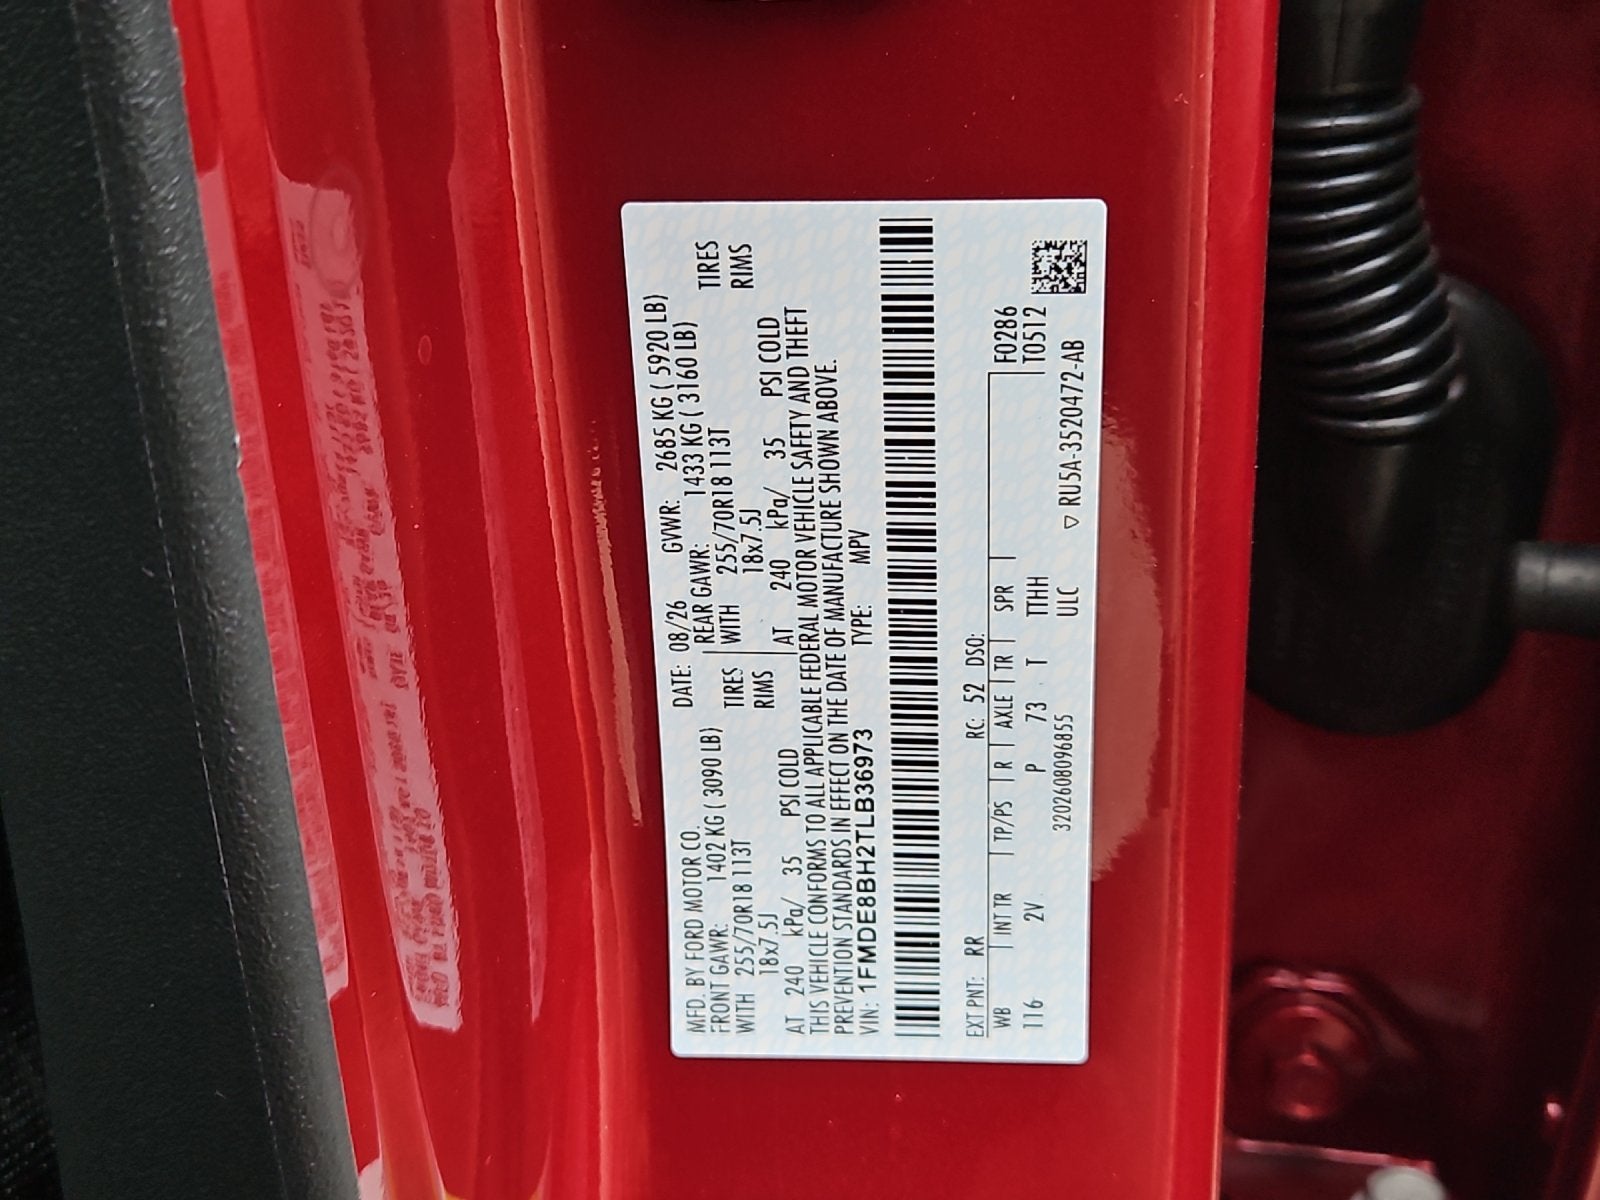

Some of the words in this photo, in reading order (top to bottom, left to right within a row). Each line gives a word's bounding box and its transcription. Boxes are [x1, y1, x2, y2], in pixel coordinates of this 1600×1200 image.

[694, 241, 721, 290] TIRES
[728, 244, 754, 289] RIMS
[642, 294, 669, 323] LB)
[672, 322, 698, 350] LB)
[757, 317, 782, 363] COLD
[784, 306, 809, 360] THEFT
[993, 306, 1018, 363] F0286
[1022, 307, 1046, 364] T0512
[645, 330, 671, 376] 5920
[674, 357, 700, 403] 3160
[759, 371, 783, 397] PSI
[787, 366, 811, 404] AND
[814, 359, 839, 423] ABOVE.
[650, 397, 674, 420] KG
[1058, 340, 1085, 506] RU5A-3520472-AB
[653, 427, 678, 471] 2685
[679, 423, 704, 446] KG
[707, 427, 732, 468] 113T
[762, 437, 786, 459] 35
[788, 409, 813, 470] SAFETY
[681, 453, 706, 497] 1433
[816, 430, 841, 494] SHOWN
[659, 500, 683, 553] GVWR:
[710, 476, 739, 575] 255/70R18
[763, 486, 791, 529] kPa/
[791, 476, 816, 543] VEHICLE
[738, 509, 764, 574] 18x7.5J
[819, 500, 845, 622] MANUFACTURE
[848, 529, 871, 565] MPV
[688, 544, 712, 597] GAWR:
[768, 559, 792, 591] 240
[795, 549, 819, 608] MOTOR
[994, 585, 1014, 612] SPR
[1026, 576, 1049, 617] TTHH
[1056, 587, 1079, 617] ULC
[664, 600, 692, 652] 08/26
[691, 603, 715, 644] REAR
[718, 605, 742, 645] WITH
[772, 626, 794, 646] AT
[824, 627, 846, 648] OF
[850, 605, 873, 646] TYPE:
[797, 613, 821, 681] FEDERAL
[965, 634, 985, 666] DSO:
[994, 655, 1014, 672] TR
[1025, 658, 1048, 667] T
[670, 665, 693, 708] DATE:
[721, 667, 745, 709] TIRES
[751, 671, 775, 709] RIMS
[825, 653, 848, 692] DATE
[826, 698, 848, 727] THE
[962, 683, 985, 704] 52
[993, 695, 1013, 729] AXLE
[1025, 702, 1047, 722] 73
[699, 727, 723, 752] LB)
[800, 687, 825, 777] APPLICABLE
[827, 732, 849, 754] ON
[965, 718, 985, 739] RC:
[700, 758, 724, 797] 3090
[777, 749, 800, 788] COLD
[993, 761, 1013, 769] R
[1024, 763, 1047, 772] P
[1052, 714, 1073, 831] 3202608096855
[804, 782, 826, 809] ALL
[828, 760, 851, 811] EFFECT
[779, 794, 801, 817] PSI
[805, 814, 826, 834] TO
[830, 817, 851, 833] IN
[990, 801, 1015, 842] TP/PS
[680, 826, 701, 850] CO.
[703, 815, 725, 836] KG
[705, 843, 727, 882] 1402
[730, 839, 752, 876] 113T
[781, 856, 803, 876] 35
[852, 729, 877, 993] 1FMDE8BH2TLB36973
[681, 856, 704, 913] MOTOR
[805, 839, 828, 924] CONFORMS
[830, 839, 853, 931] STANDARDS
[993, 893, 1012, 908] TR
[732, 884, 757, 976] 255/70R18
[780, 897, 806, 937] kPa/
[993, 912, 1012, 935] INT
[1023, 902, 1045, 922] 2V
[684, 919, 705, 960] FORD
[708, 924, 730, 975] GAWR:
[757, 914, 779, 975] 18x7.5J
[964, 936, 984, 956] RR
[685, 967, 705, 986] BY
[784, 966, 805, 996] 240
[808, 931, 829, 994] VEHICLE
[833, 937, 854, 1034] PREVENTION
[966, 977, 984, 1008] PNT:
[686, 994, 706, 1033] MFD.
[710, 981, 731, 1033] FRONT
[735, 994, 755, 1034] WITH
[785, 1015, 805, 1035] AT
[809, 1000, 830, 1035] THIS
[859, 1003, 879, 1035] VIN:
[966, 1012, 984, 1037] EXT
[993, 1007, 1011, 1029] WB
[1022, 999, 1044, 1029] 116
